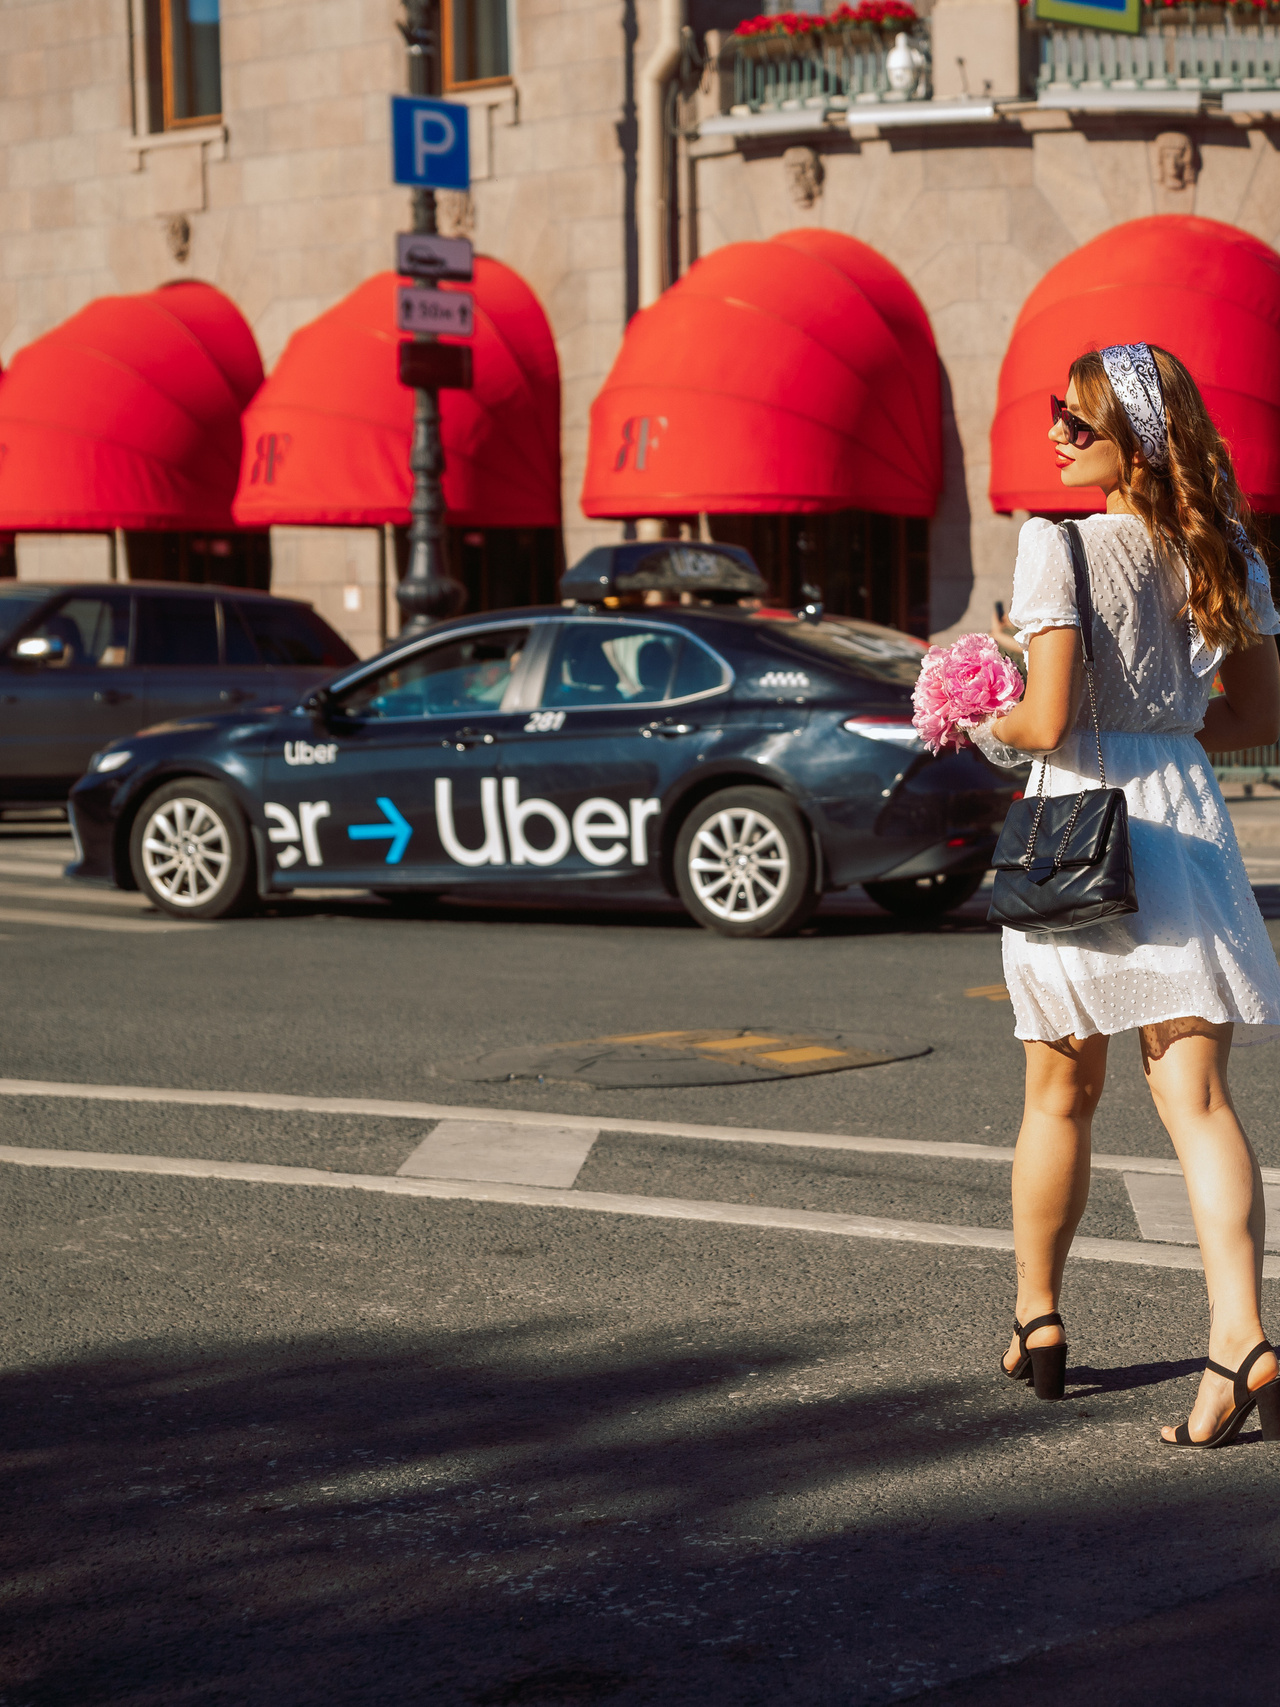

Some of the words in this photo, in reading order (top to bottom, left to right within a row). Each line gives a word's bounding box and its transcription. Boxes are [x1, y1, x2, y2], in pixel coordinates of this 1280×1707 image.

[413, 108, 456, 177] P
[284, 740, 339, 766] Uber
[435, 776, 661, 868] Uber
